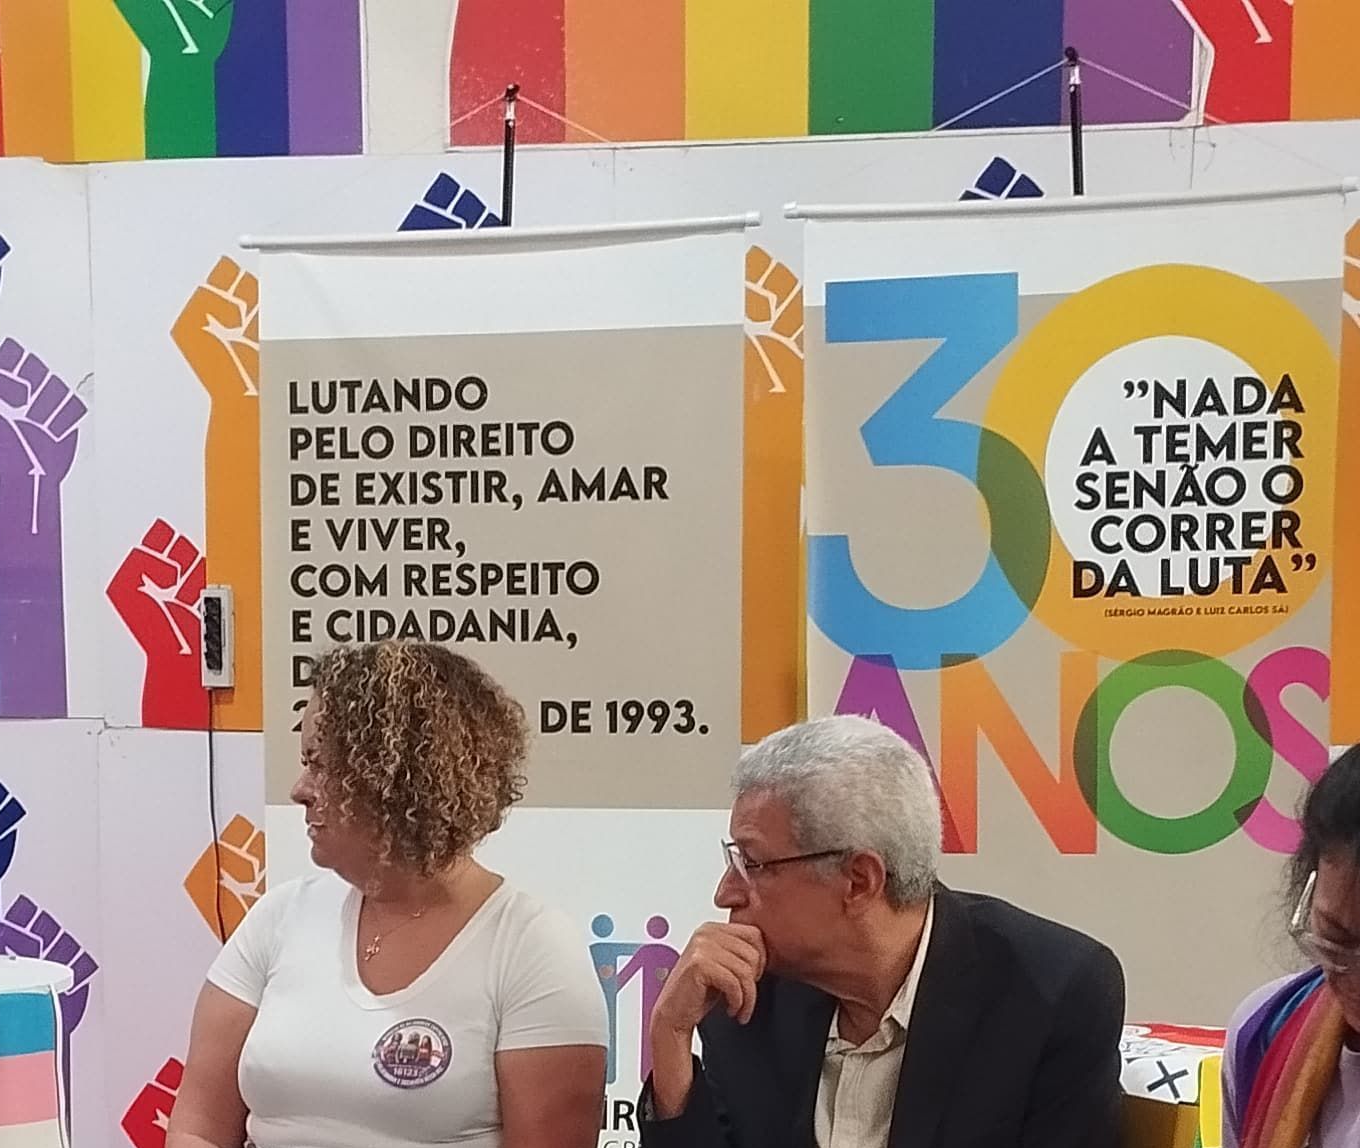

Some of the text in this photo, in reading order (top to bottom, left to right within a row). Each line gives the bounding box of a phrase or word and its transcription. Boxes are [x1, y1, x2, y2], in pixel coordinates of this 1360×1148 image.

[289, 376, 488, 415] LUTANDO
[290, 421, 574, 460] PELO DIREITO
[1080, 420, 1304, 468] A TEMER
[807, 263, 1341, 669] 30
[290, 466, 669, 510] DE EXISTIR, AMAR
[1074, 463, 1304, 511] SENÃO O
[291, 517, 466, 556] E VIVER,
[1090, 510, 1301, 554] CORRER
[291, 561, 600, 597] COM RESPEITO
[1072, 558, 1139, 599] DA
[292, 608, 578, 649] E CIDADANIA,
[1147, 606, 1193, 616] MAGRÃO
[1204, 607, 1226, 615] LUIZ
[1228, 606, 1270, 615] CARLOS
[540, 700, 710, 735] DE 1993.
